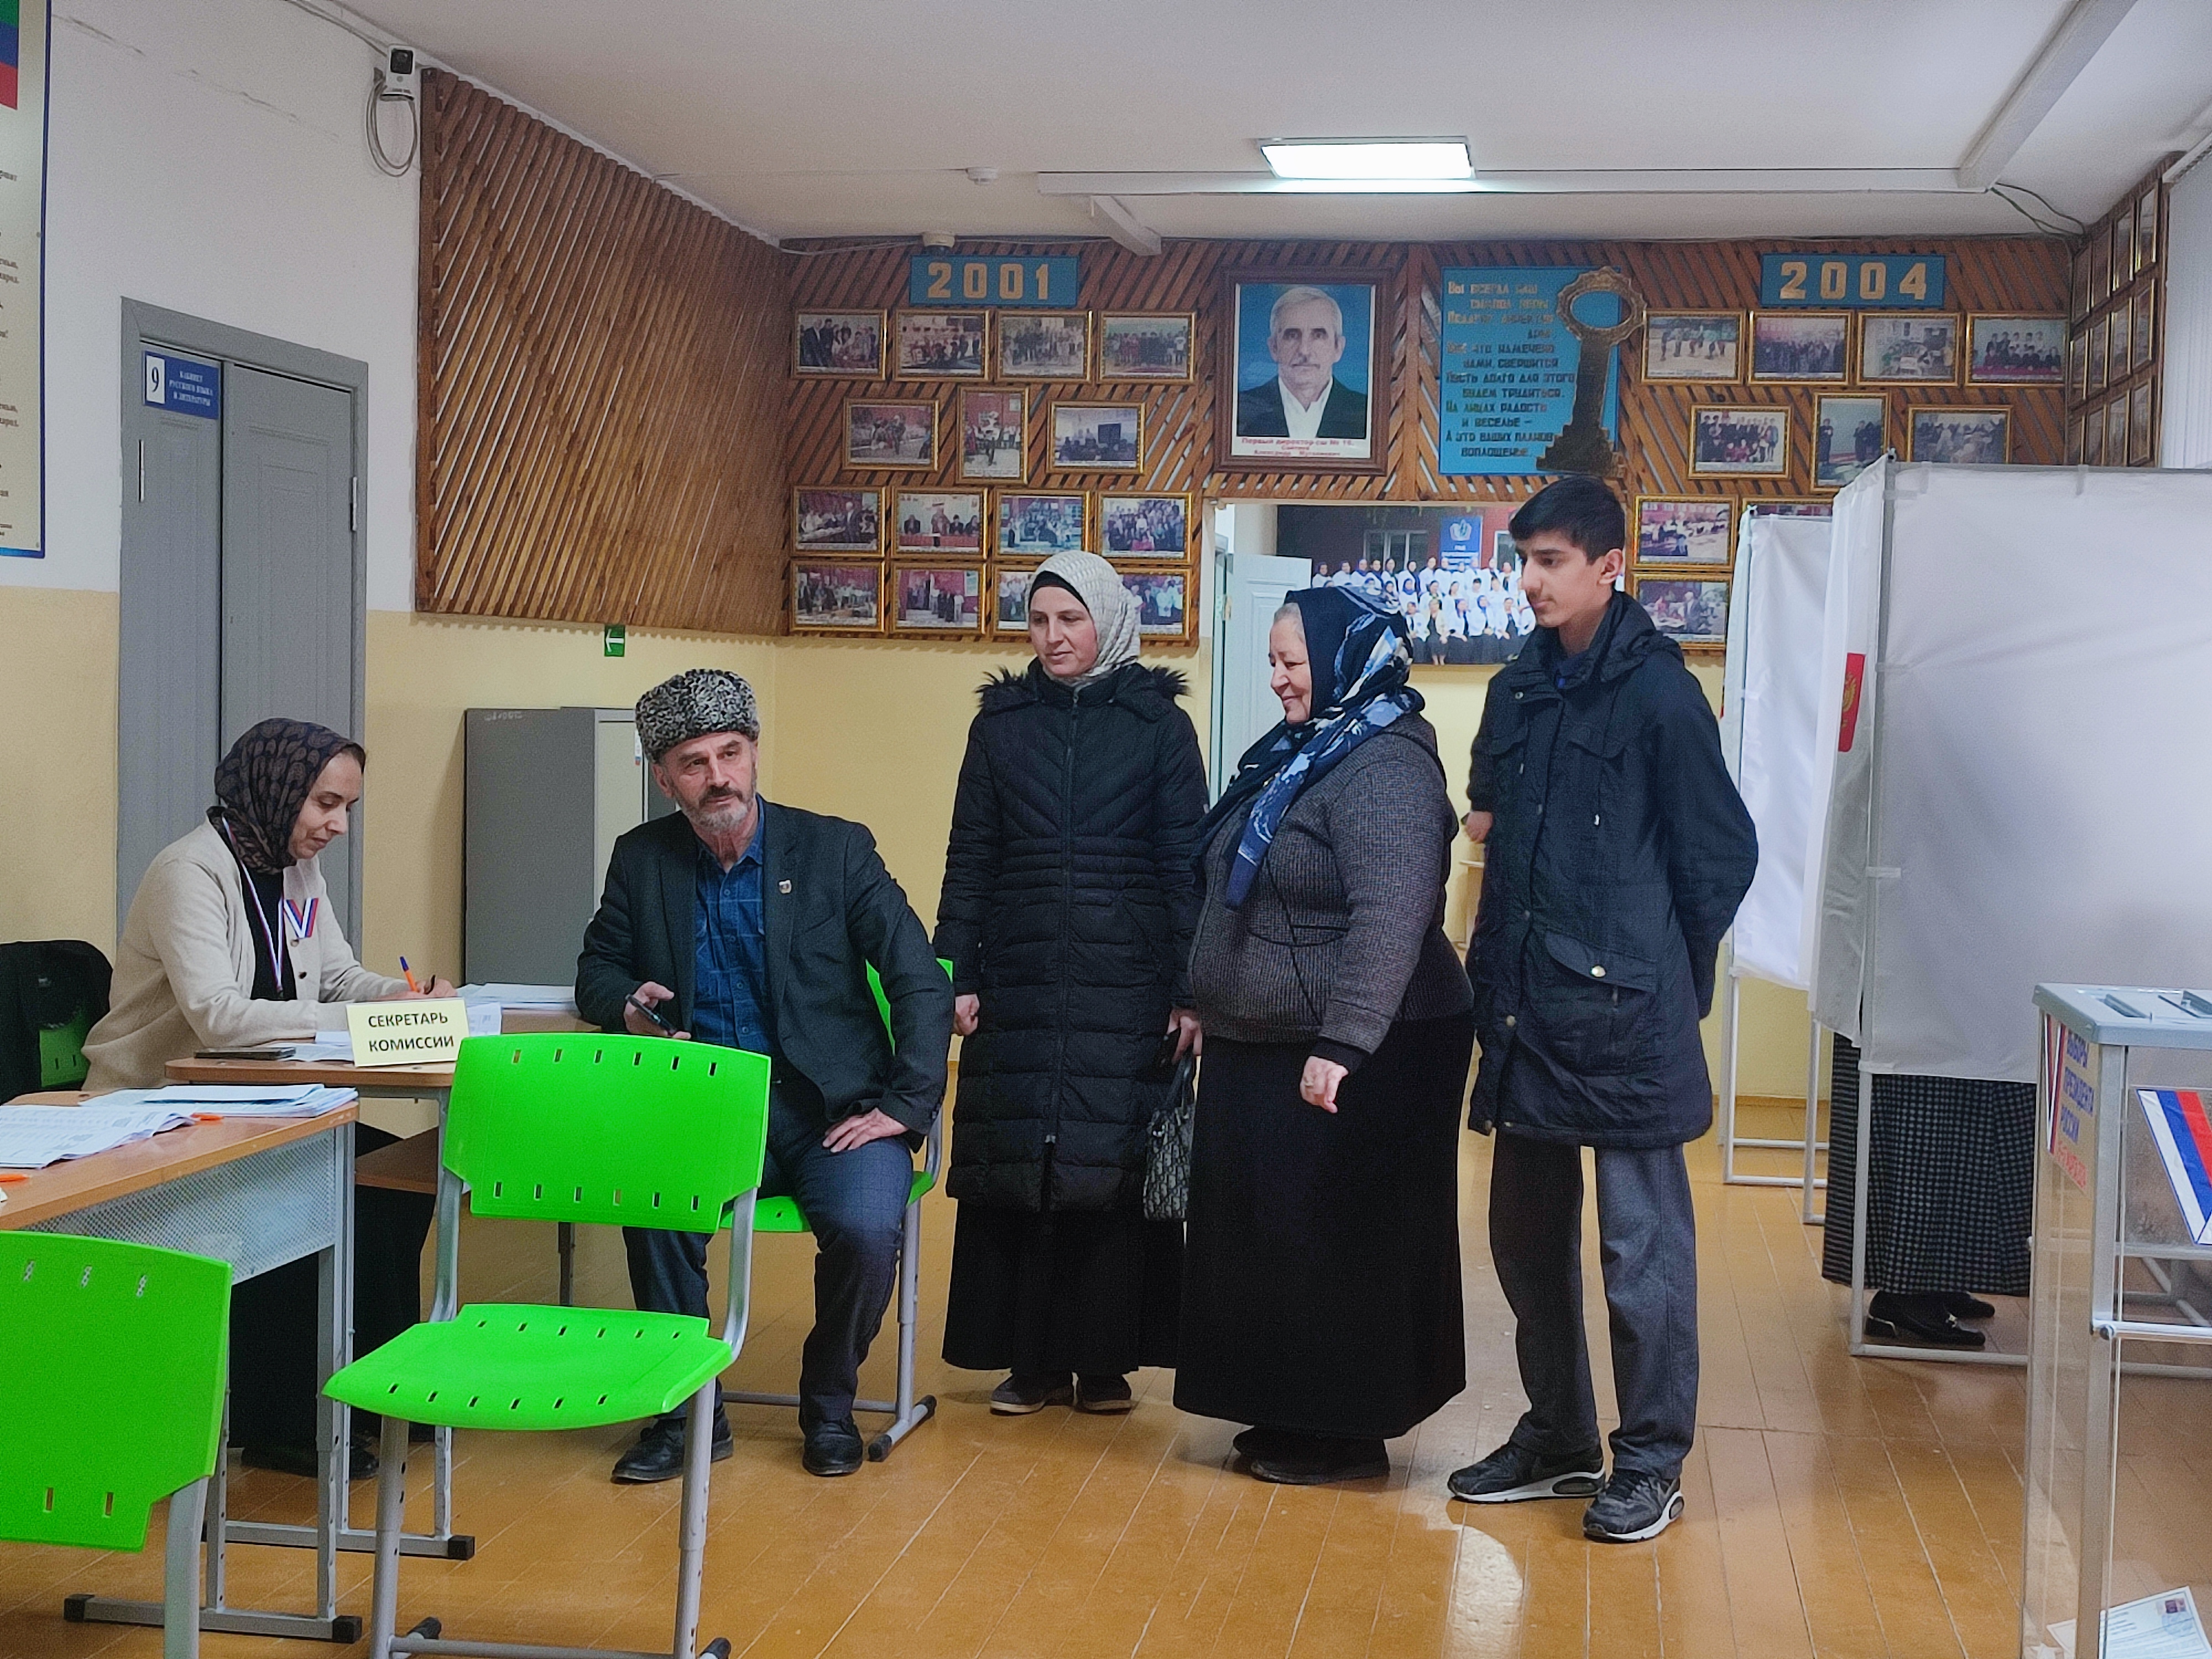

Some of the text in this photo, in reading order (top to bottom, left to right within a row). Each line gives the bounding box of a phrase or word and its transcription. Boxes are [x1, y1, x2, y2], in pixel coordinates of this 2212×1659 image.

[927, 262, 1048, 300] 2001
[1780, 261, 1927, 300] 2004
[1472, 344, 1492, 353] ЧТО
[1498, 343, 1554, 353] НАМЕЧЕНО
[1498, 358, 1559, 368] СВЕРШИТСЯ
[152, 367, 159, 392] 9
[1483, 373, 1515, 383] ДОЛГО
[1519, 373, 1539, 383] ДЛЯ
[1543, 373, 1575, 383] ЭТОГО
[1500, 403, 1547, 413] РАДОСТЬ
[1462, 418, 1469, 427] И
[1475, 417, 1521, 427] ВЕСЕЛЬЕ
[1446, 430, 1453, 442] А
[1455, 432, 1476, 442] ЭТО
[368, 1012, 448, 1027] СЕКРЕТАРЬ
[368, 1035, 454, 1052] КОМИССИИ
